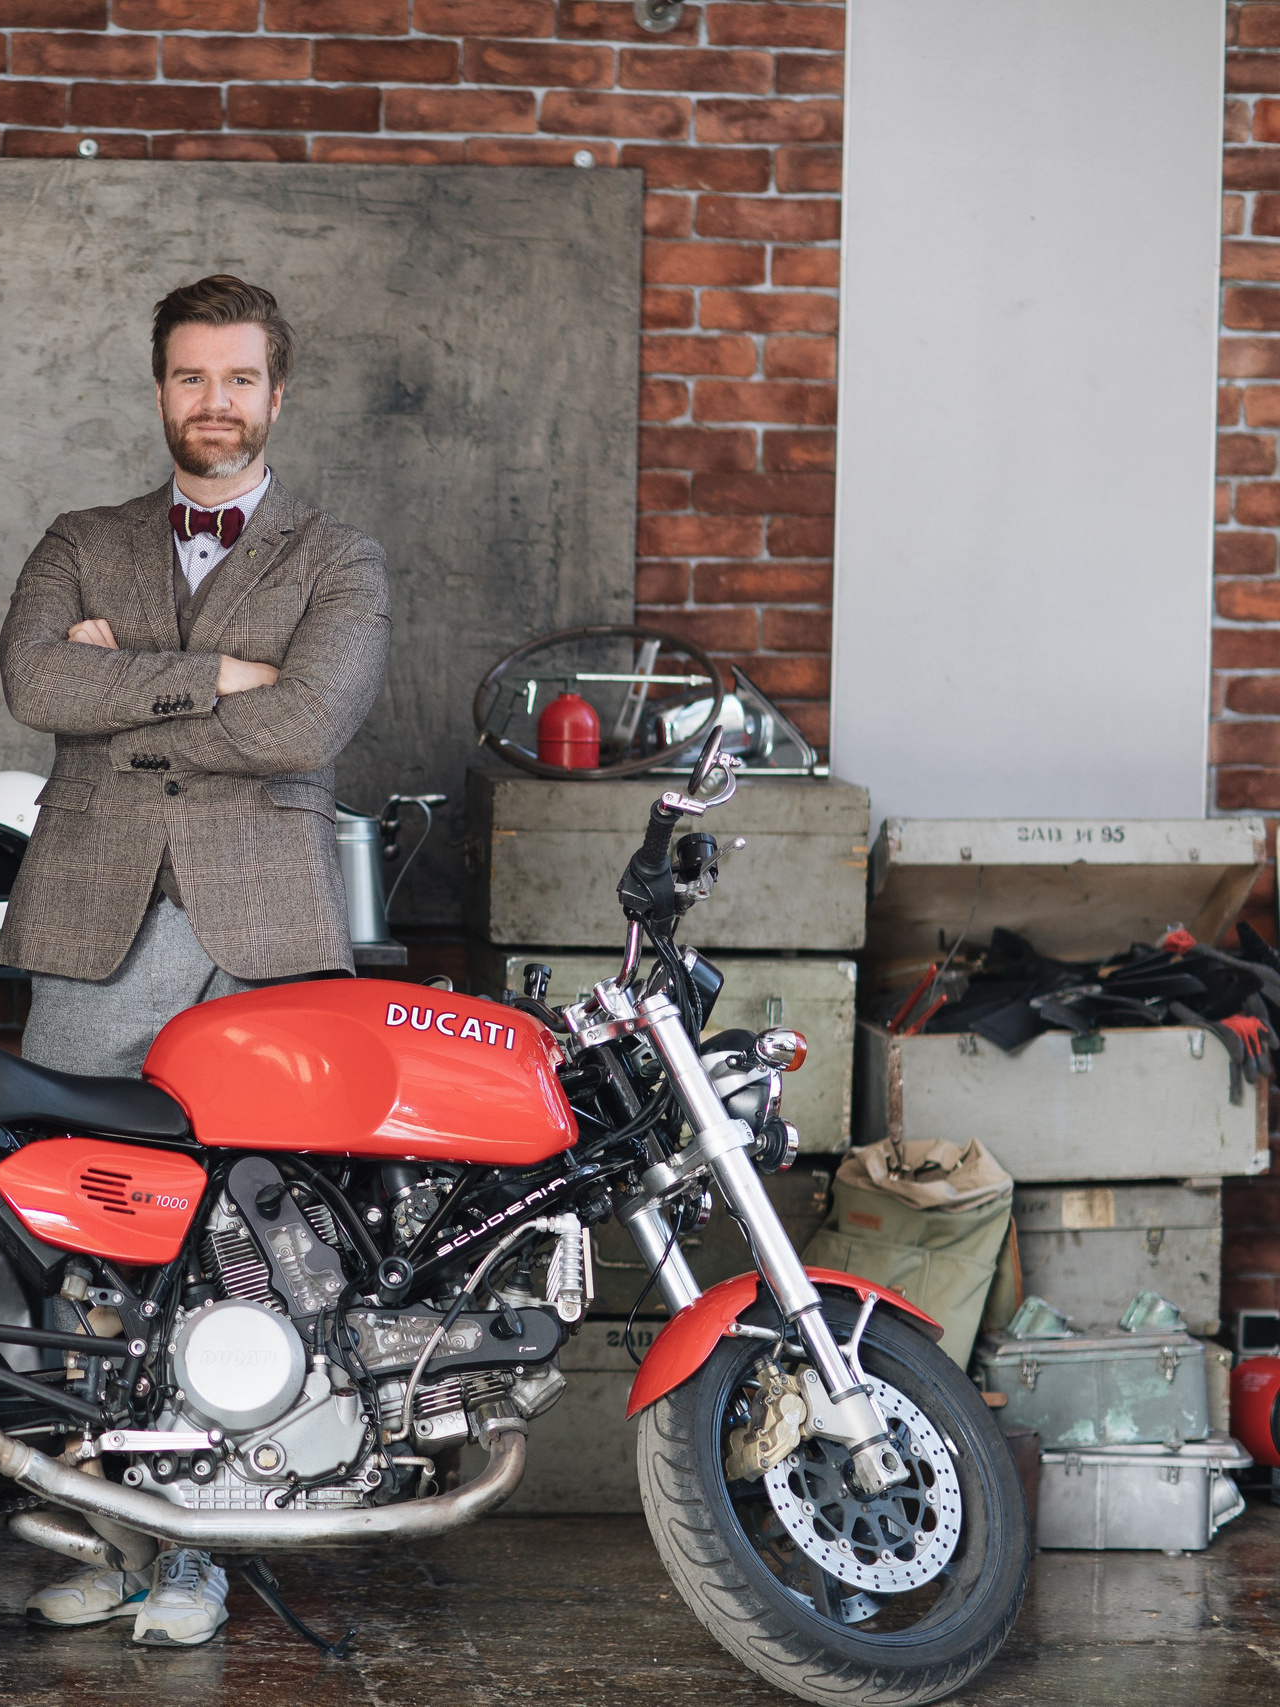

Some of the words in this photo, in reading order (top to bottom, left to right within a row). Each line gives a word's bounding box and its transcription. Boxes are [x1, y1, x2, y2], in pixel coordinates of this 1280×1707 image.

[385, 1002, 516, 1050] DUCATI
[131, 1191, 155, 1204] GT
[155, 1194, 189, 1210] 1000
[436, 1177, 568, 1258] SCUDERIA
[200, 1349, 278, 1367] DUCATI
